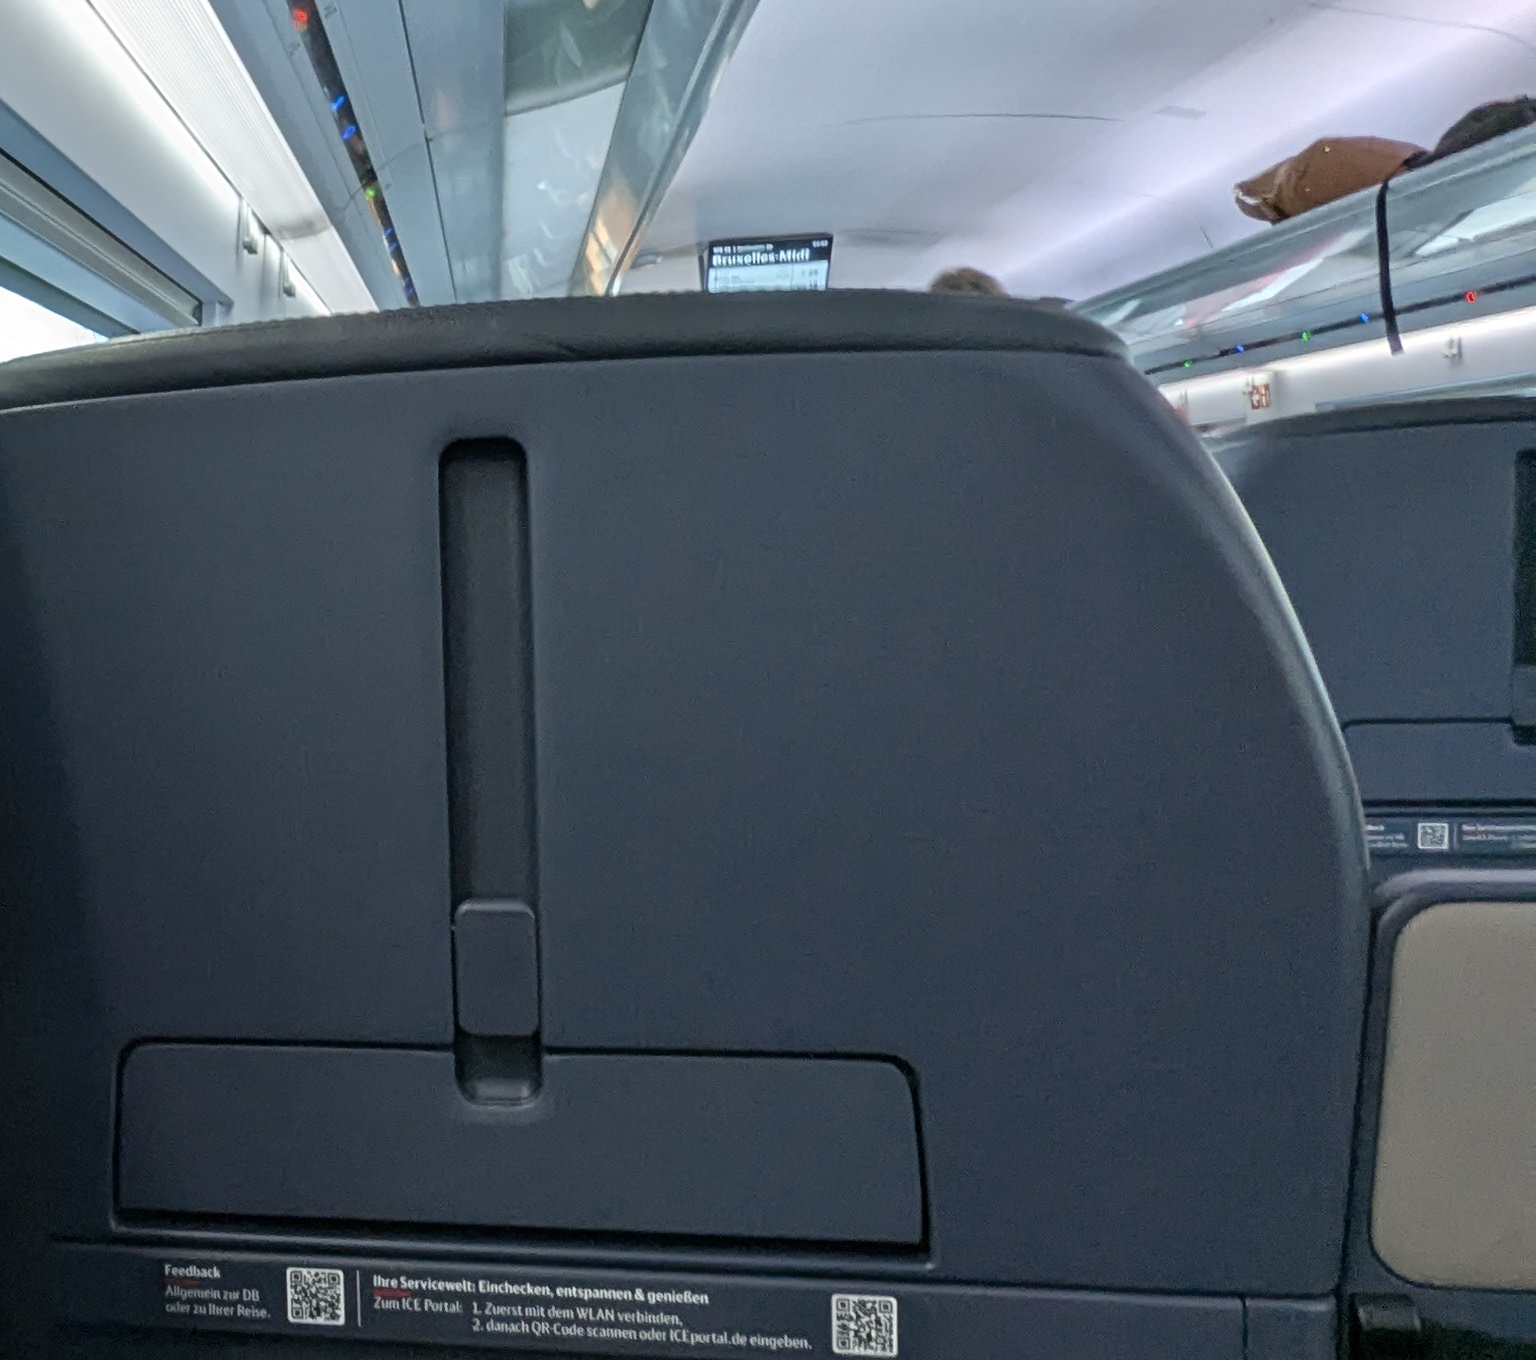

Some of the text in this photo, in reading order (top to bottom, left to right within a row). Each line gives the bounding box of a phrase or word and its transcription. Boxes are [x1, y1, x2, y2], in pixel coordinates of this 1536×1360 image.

[164, 1263, 222, 1279] Feedback
[165, 1284, 222, 1301] Allgemein
[222, 1289, 241, 1301] zur
[372, 1274, 710, 1305] Ihre Servicewelt: Einchecken, entspannen & genießen
[193, 1304, 207, 1315] zu
[373, 1296, 401, 1310] Zum
[401, 1297, 423, 1312] ICE
[472, 1301, 684, 1327] 1. Zuerst mit dem WLAN verbinden,
[472, 1317, 813, 1350] 2. danach QR-Code scannen oder ICEportal.de eingeben.
